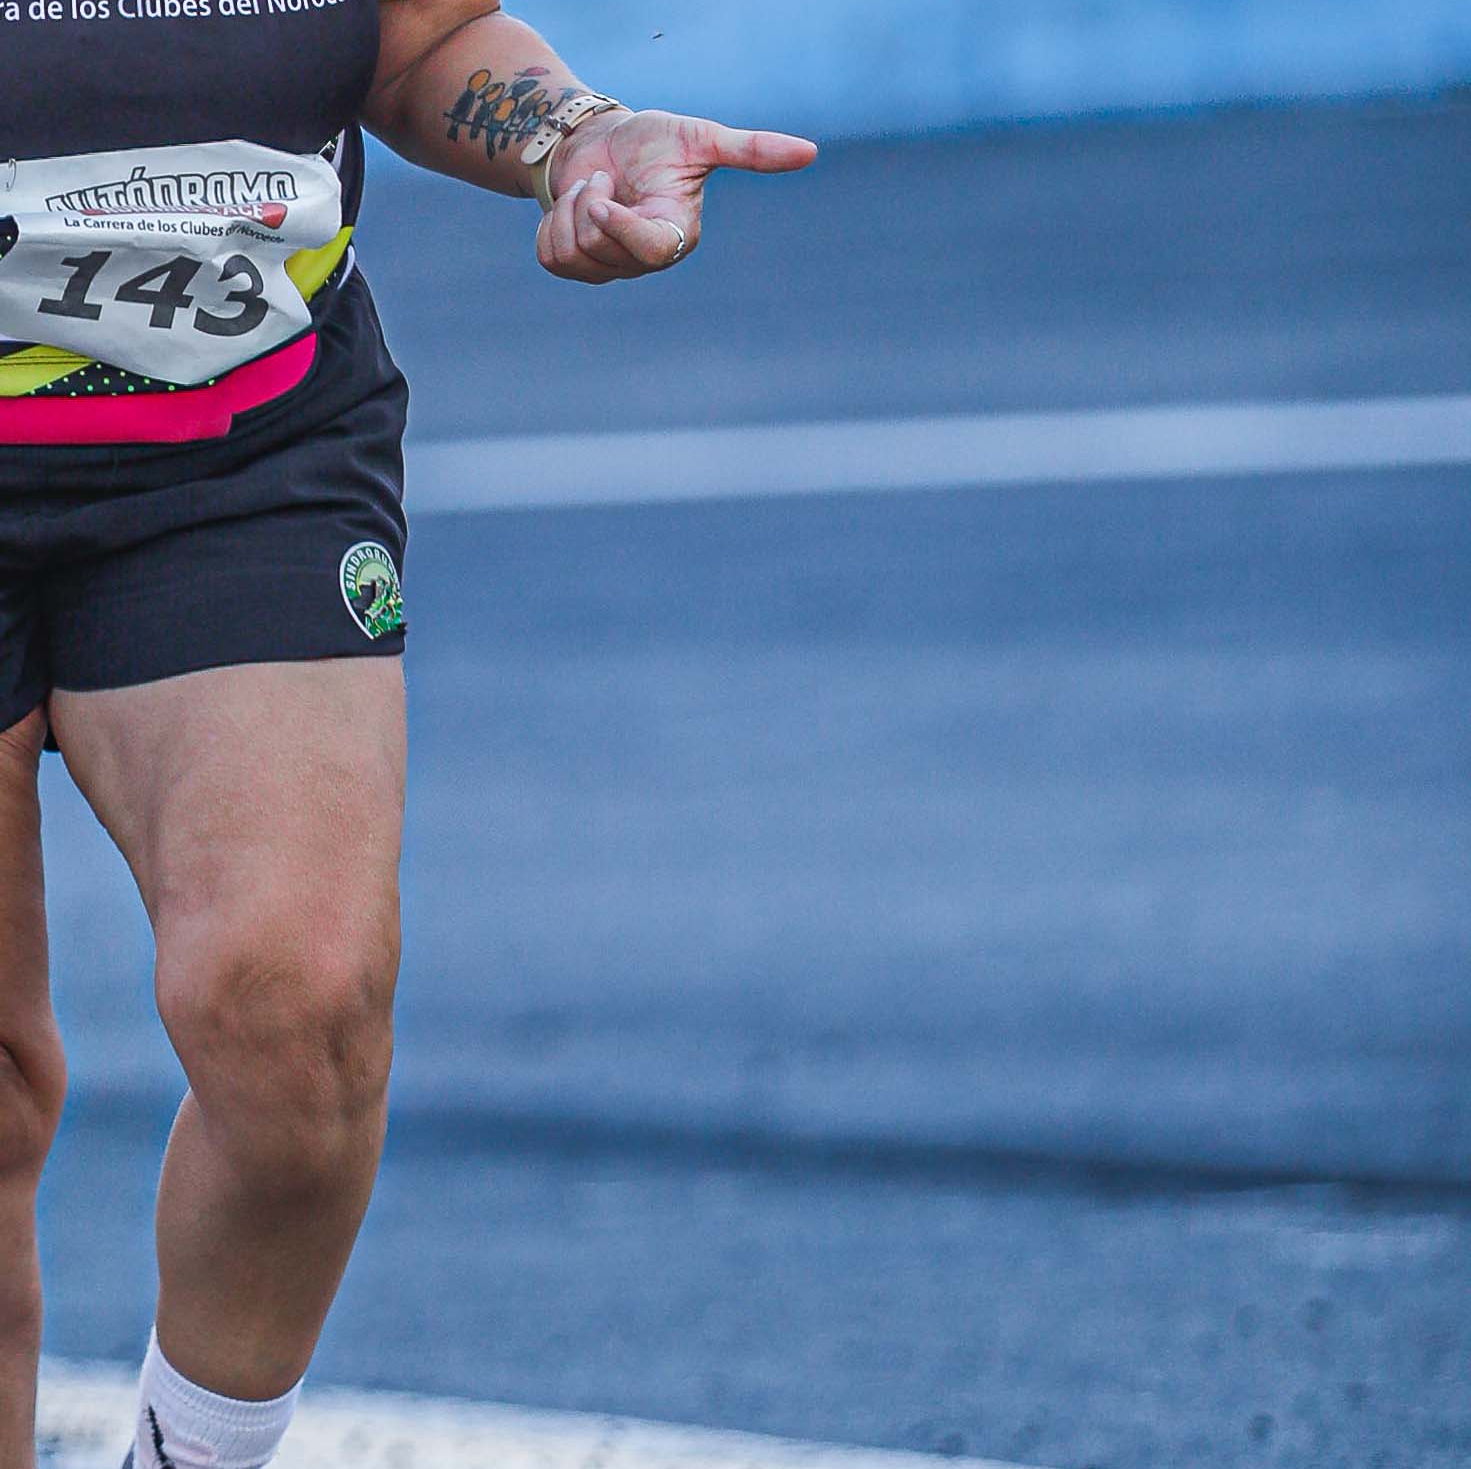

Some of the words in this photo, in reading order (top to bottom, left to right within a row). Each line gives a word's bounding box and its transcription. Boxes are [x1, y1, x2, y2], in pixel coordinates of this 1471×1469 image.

[63, 216, 81, 228] La
[83, 216, 135, 231] Carrera
[137, 218, 156, 233] de
[157, 219, 178, 234] los
[180, 220, 225, 237] Clubes
[37, 250, 269, 337] 143
